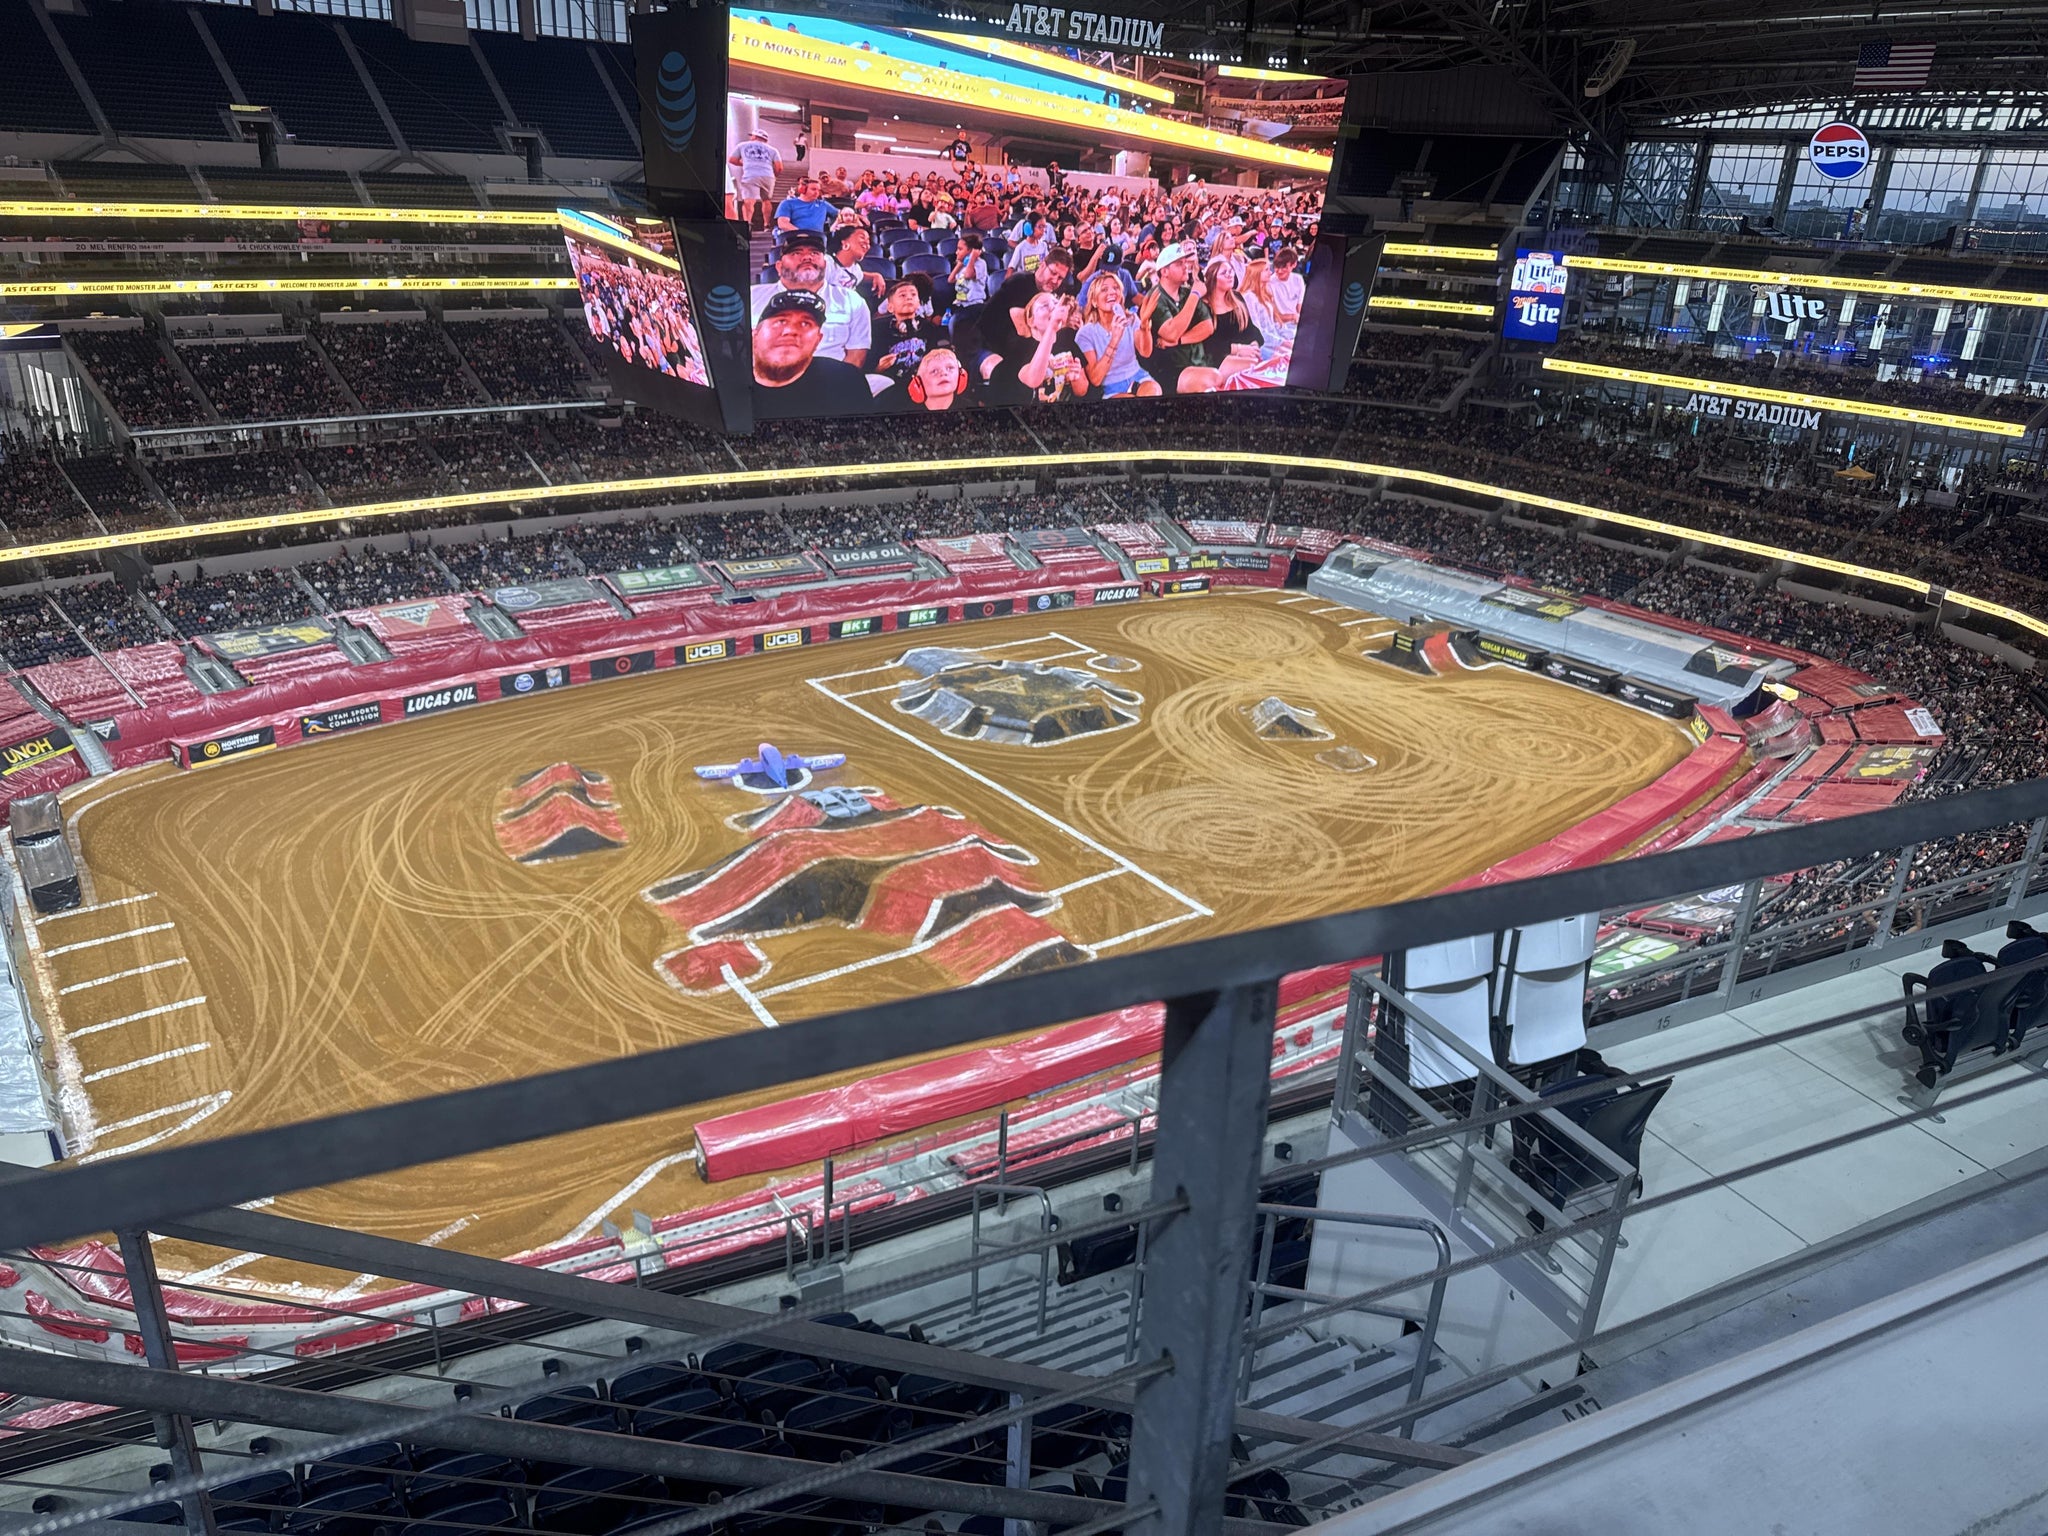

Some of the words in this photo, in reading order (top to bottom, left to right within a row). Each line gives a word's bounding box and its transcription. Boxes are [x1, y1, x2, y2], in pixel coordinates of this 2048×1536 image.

[1006, 3, 1065, 37] AT&T
[1068, 11, 1165, 50] STADIUM
[744, 36, 760, 47] TO
[764, 41, 821, 62] MONSTER
[825, 57, 847, 67] JAM
[1812, 145, 1865, 158] PEPSI
[1028, 169, 1039, 178] 148
[1530, 265, 1553, 281] Lite
[1552, 274, 1566, 283] ite
[1519, 303, 1560, 326] Lite
[1766, 291, 1825, 323] Lite
[1685, 393, 1732, 416] AT&T
[1734, 400, 1822, 431] STADIUM
[833, 550, 878, 562] LUCAS
[883, 548, 904, 558] OIL
[733, 562, 775, 572] JCB
[621, 568, 692, 585] BKT
[1095, 588, 1125, 601] LUCAS
[1126, 586, 1140, 598] OIL
[908, 608, 937, 623] BKT
[841, 619, 871, 634] BKT
[767, 632, 800, 646] JCB
[689, 645, 723, 659] JCB
[1480, 640, 1501, 653] MORGAN
[1506, 648, 1527, 661] MORGAN
[407, 691, 450, 713] LUCAS
[453, 686, 475, 703] OIL
[351, 704, 379, 718] SPORTS
[329, 712, 380, 728] COMMISSION
[221, 733, 260, 748] NORTHERN
[2, 737, 54, 765] UNOH
[1985, 918, 1995, 929] 11
[1921, 937, 1932, 950] 12
[1850, 958, 1861, 971] 13
[1750, 987, 1762, 1000] 14
[1657, 1016, 1670, 1029] 15
